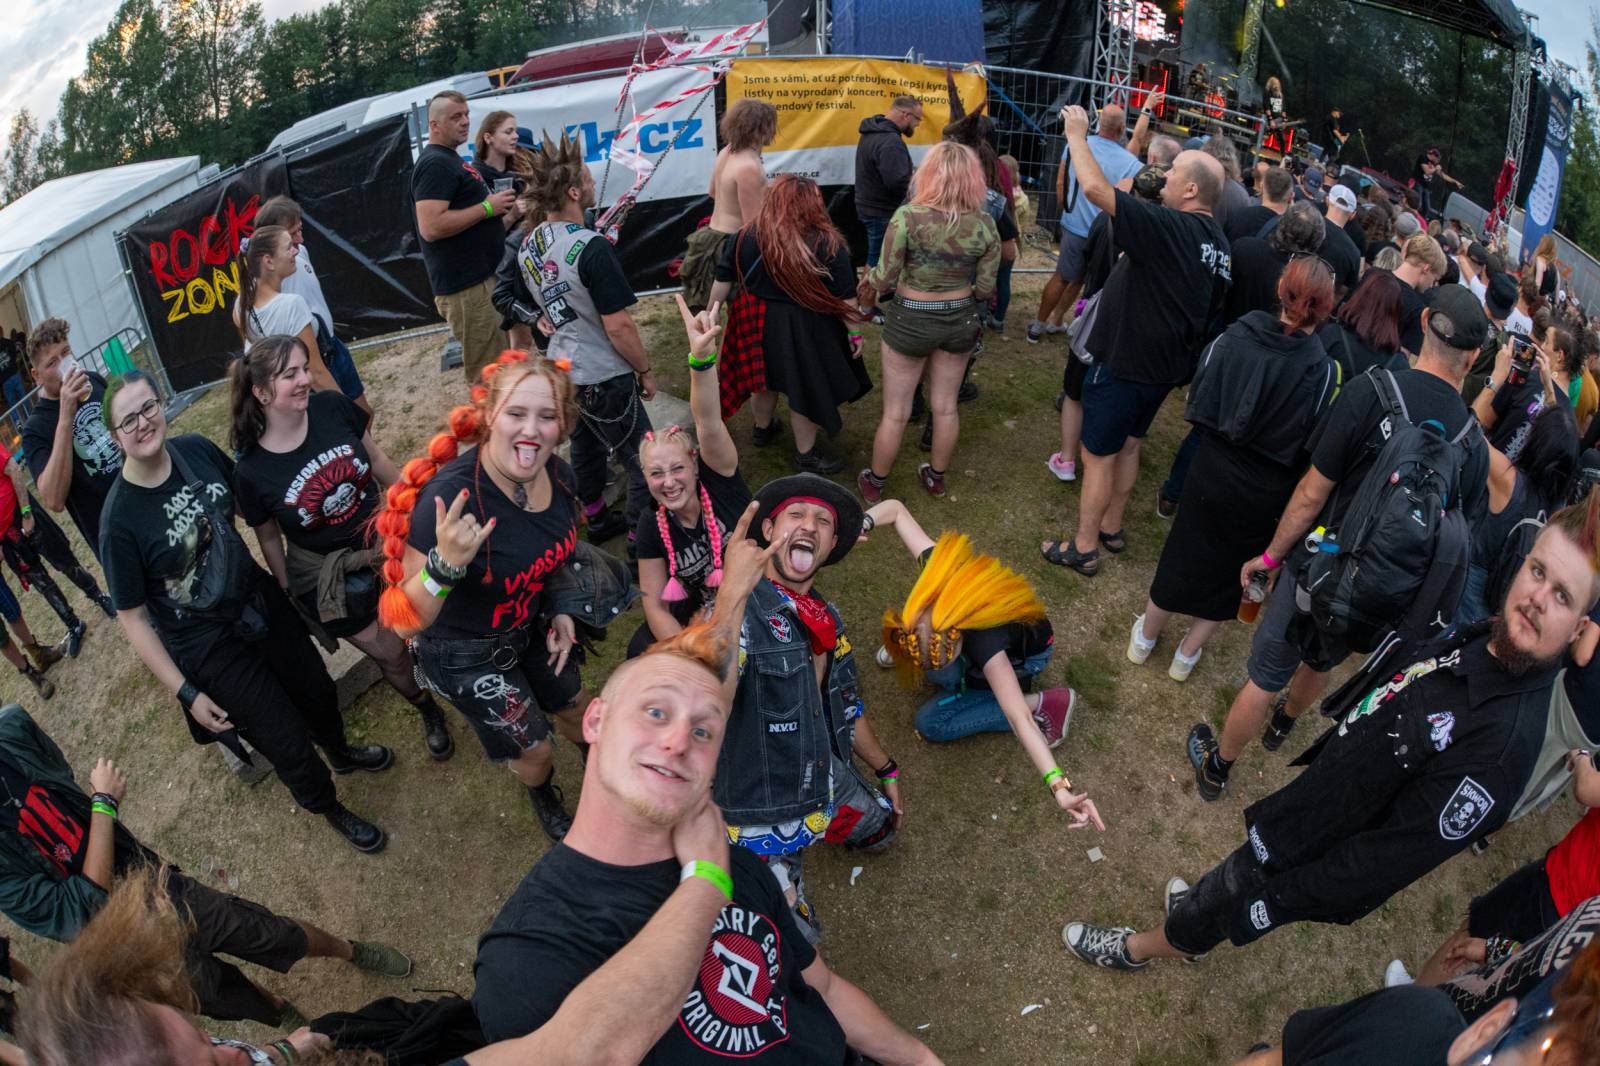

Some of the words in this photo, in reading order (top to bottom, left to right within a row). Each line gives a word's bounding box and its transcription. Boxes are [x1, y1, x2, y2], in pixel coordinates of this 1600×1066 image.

[743, 75, 770, 84] Jsme
[780, 73, 810, 83] vámi,
[824, 73, 836, 82] už
[838, 73, 897, 87] potřebujete
[899, 77, 925, 90] lepší
[744, 89, 774, 99] lístky
[791, 88, 844, 98] vyprodaný
[847, 87, 887, 98] koncert,
[775, 101, 813, 111] endový
[815, 101, 857, 110] festival.
[147, 194, 261, 292] ROCK
[161, 260, 243, 323] ZON
[284, 459, 321, 504] VISION
[317, 444, 353, 466] DAYS
[505, 526, 577, 595] VYPSAN
[683, 990, 767, 1053] ORIGINAL
